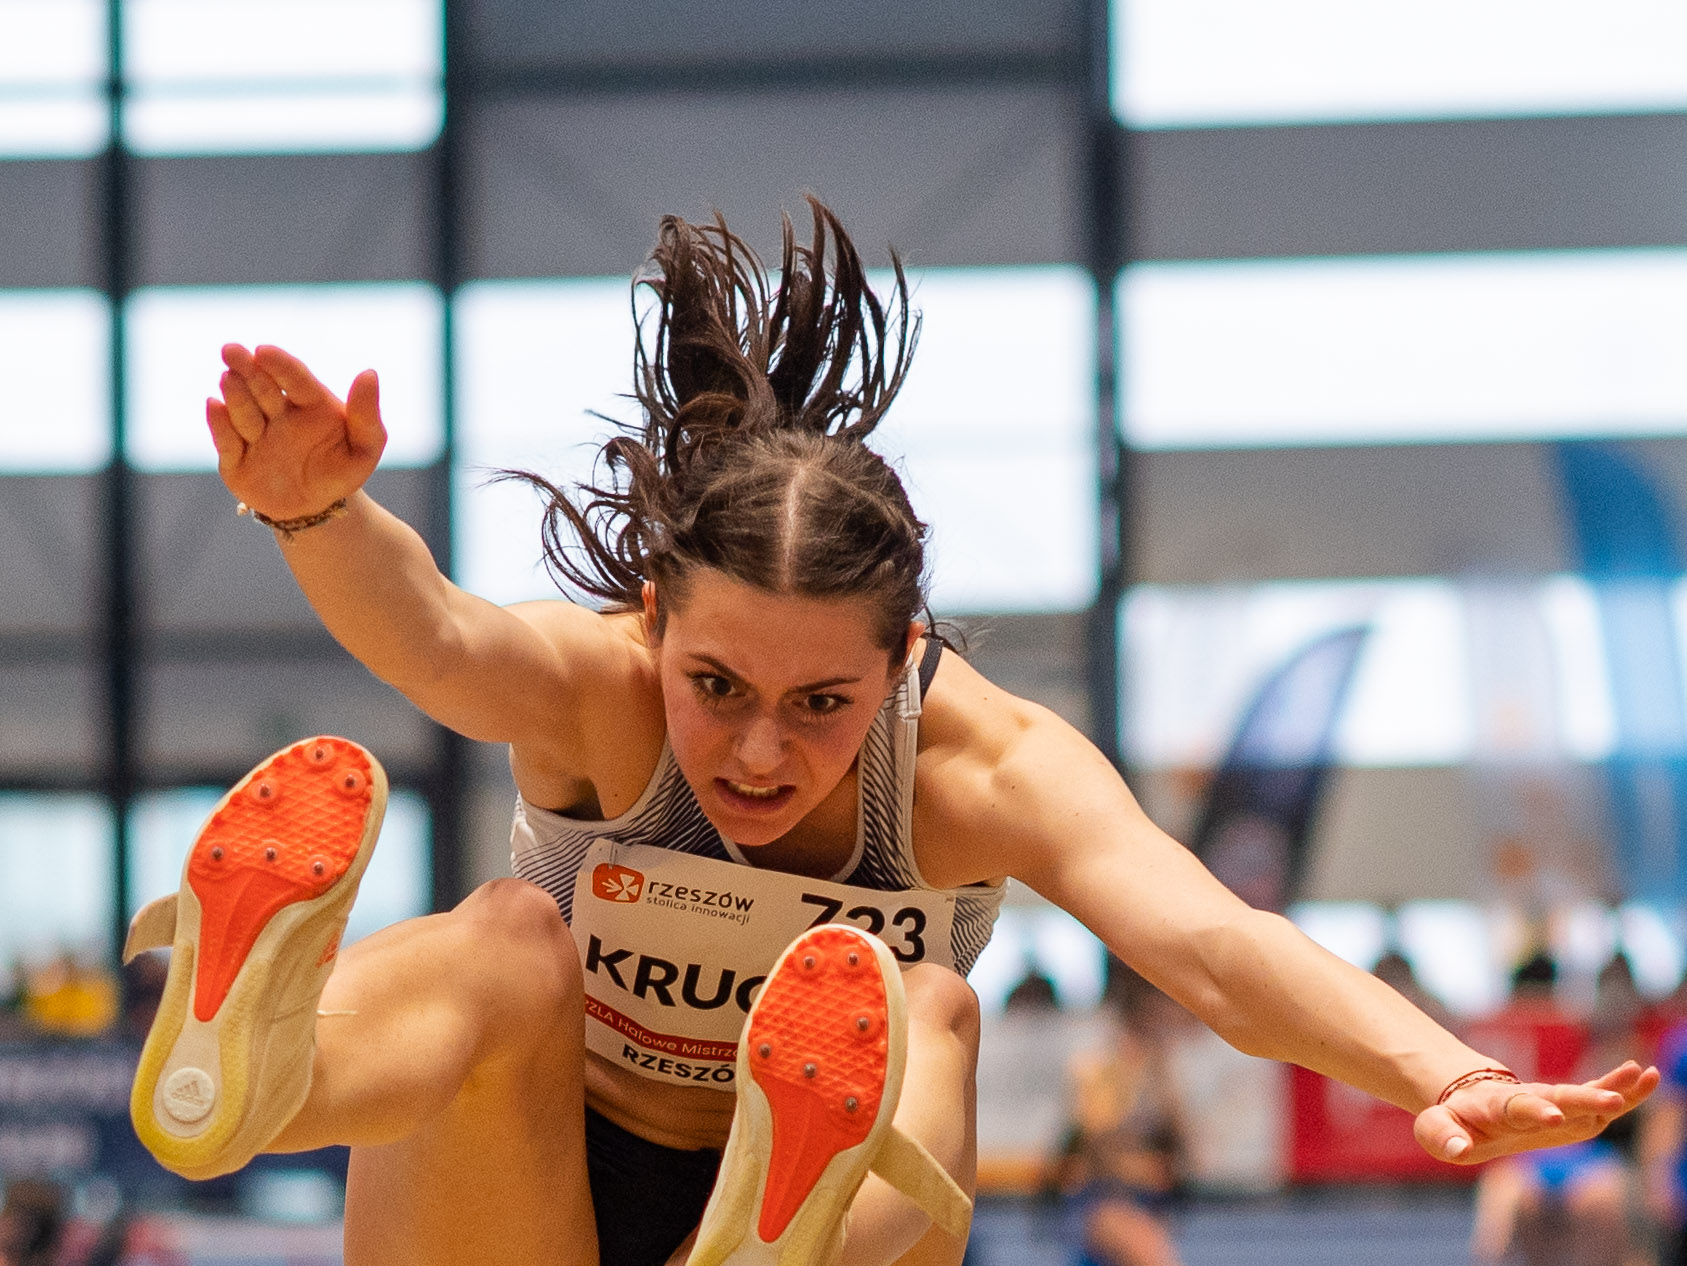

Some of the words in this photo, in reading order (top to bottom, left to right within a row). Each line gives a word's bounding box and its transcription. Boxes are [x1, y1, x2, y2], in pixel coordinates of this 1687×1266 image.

[646, 896, 687, 911] stolica
[691, 905, 750, 926] innowacji
[648, 880, 755, 912] rzeszów
[586, 1000, 614, 1023] ZLA
[618, 1017, 677, 1050] Halowe
[622, 1043, 735, 1083] RZESZÓ
